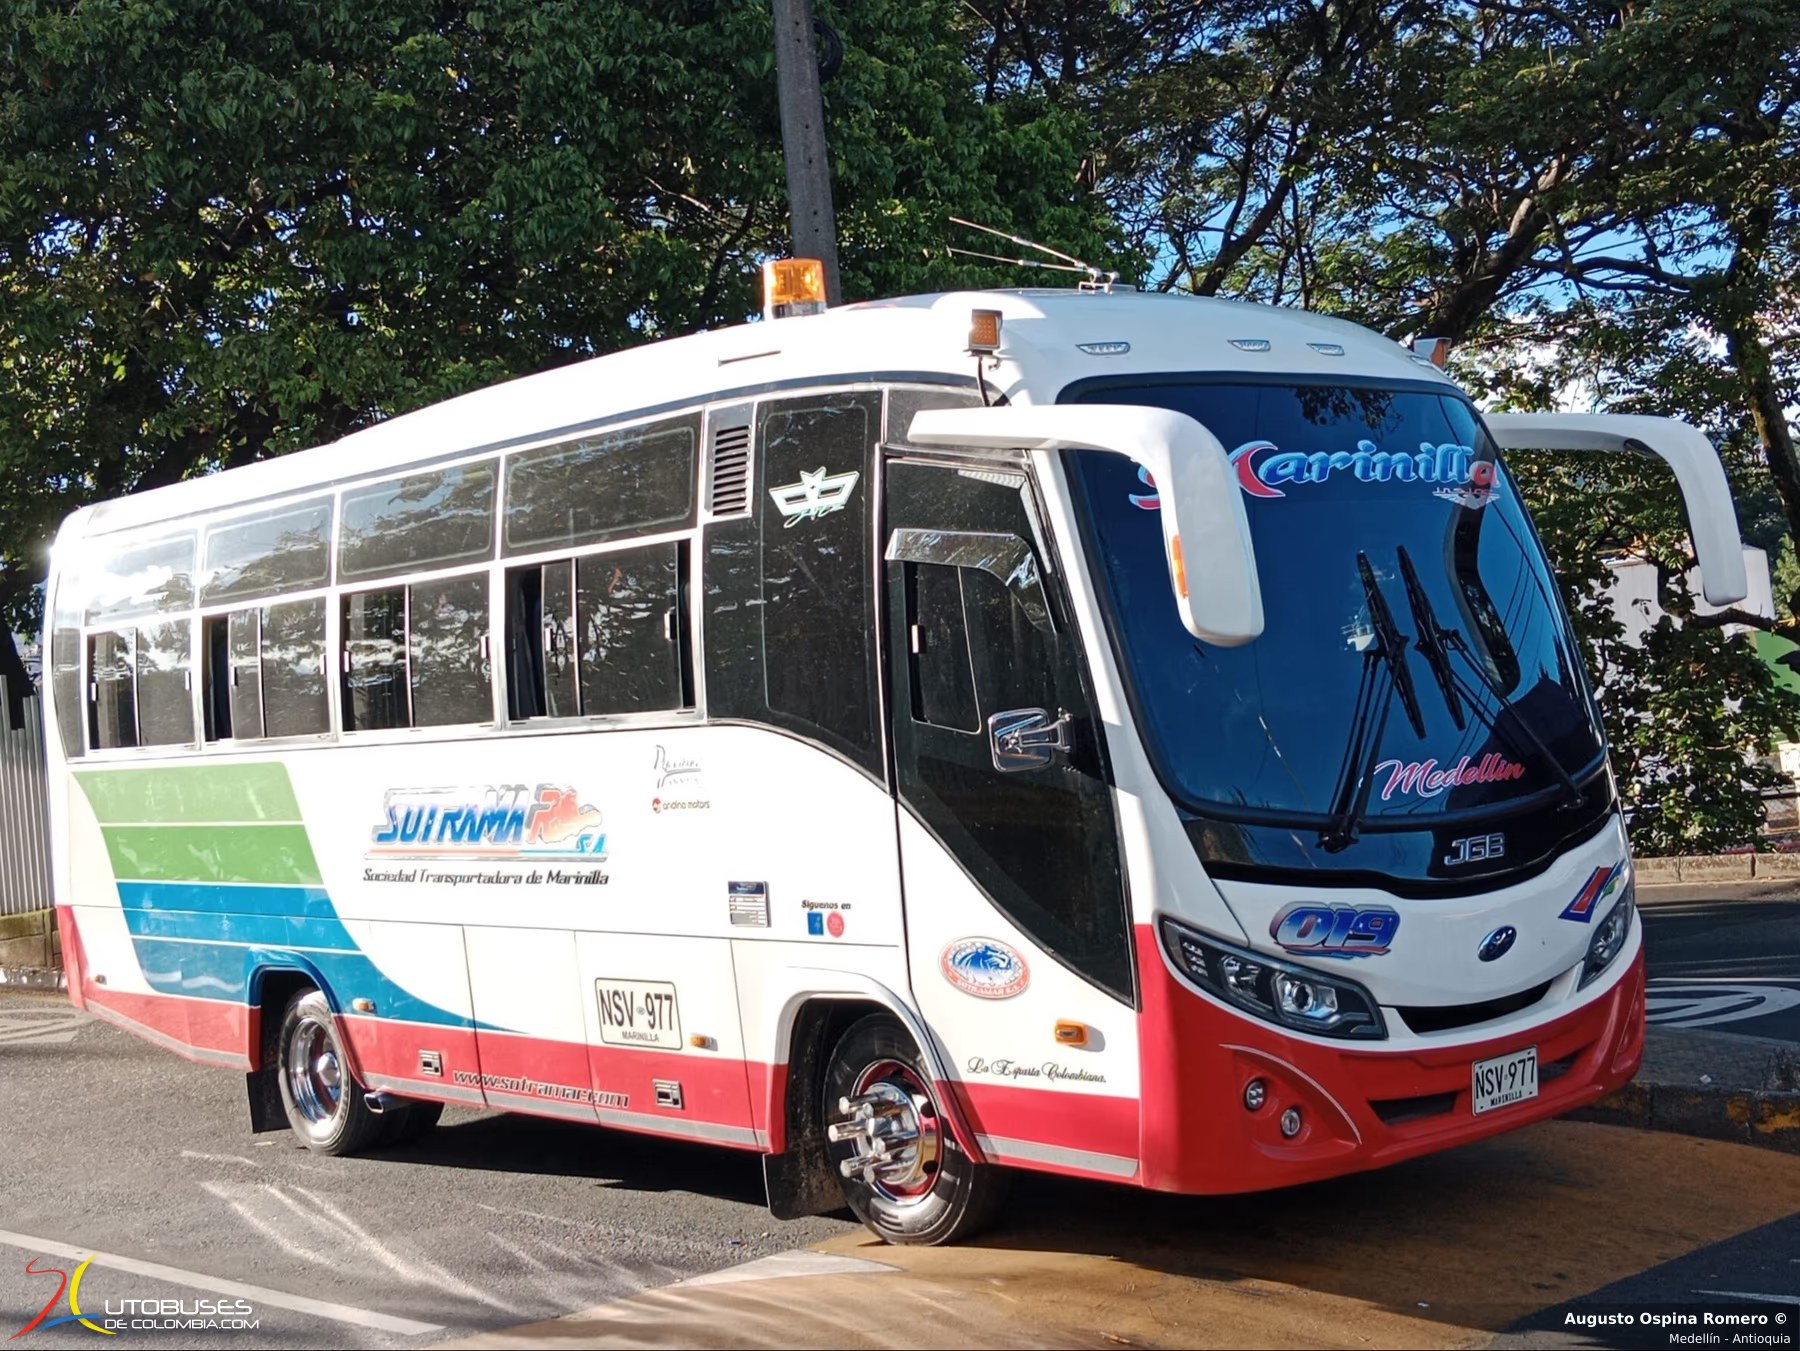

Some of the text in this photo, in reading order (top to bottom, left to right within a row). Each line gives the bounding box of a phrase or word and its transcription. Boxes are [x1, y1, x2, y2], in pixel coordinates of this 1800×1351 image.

[1444, 833, 1505, 865] JGB
[363, 868, 609, 886] Sociedad Transportadora de Marinilla
[841, 902, 851, 910] en
[1269, 900, 1400, 950] 019
[599, 989, 673, 1031] NSV 977
[621, 1031, 659, 1042] MARINILLA
[967, 1056, 990, 1074] La
[453, 1069, 631, 1109] www.sotramar.com
[1475, 1056, 1535, 1100] NSV 977
[1490, 1089, 1522, 1107] MARINILLA
